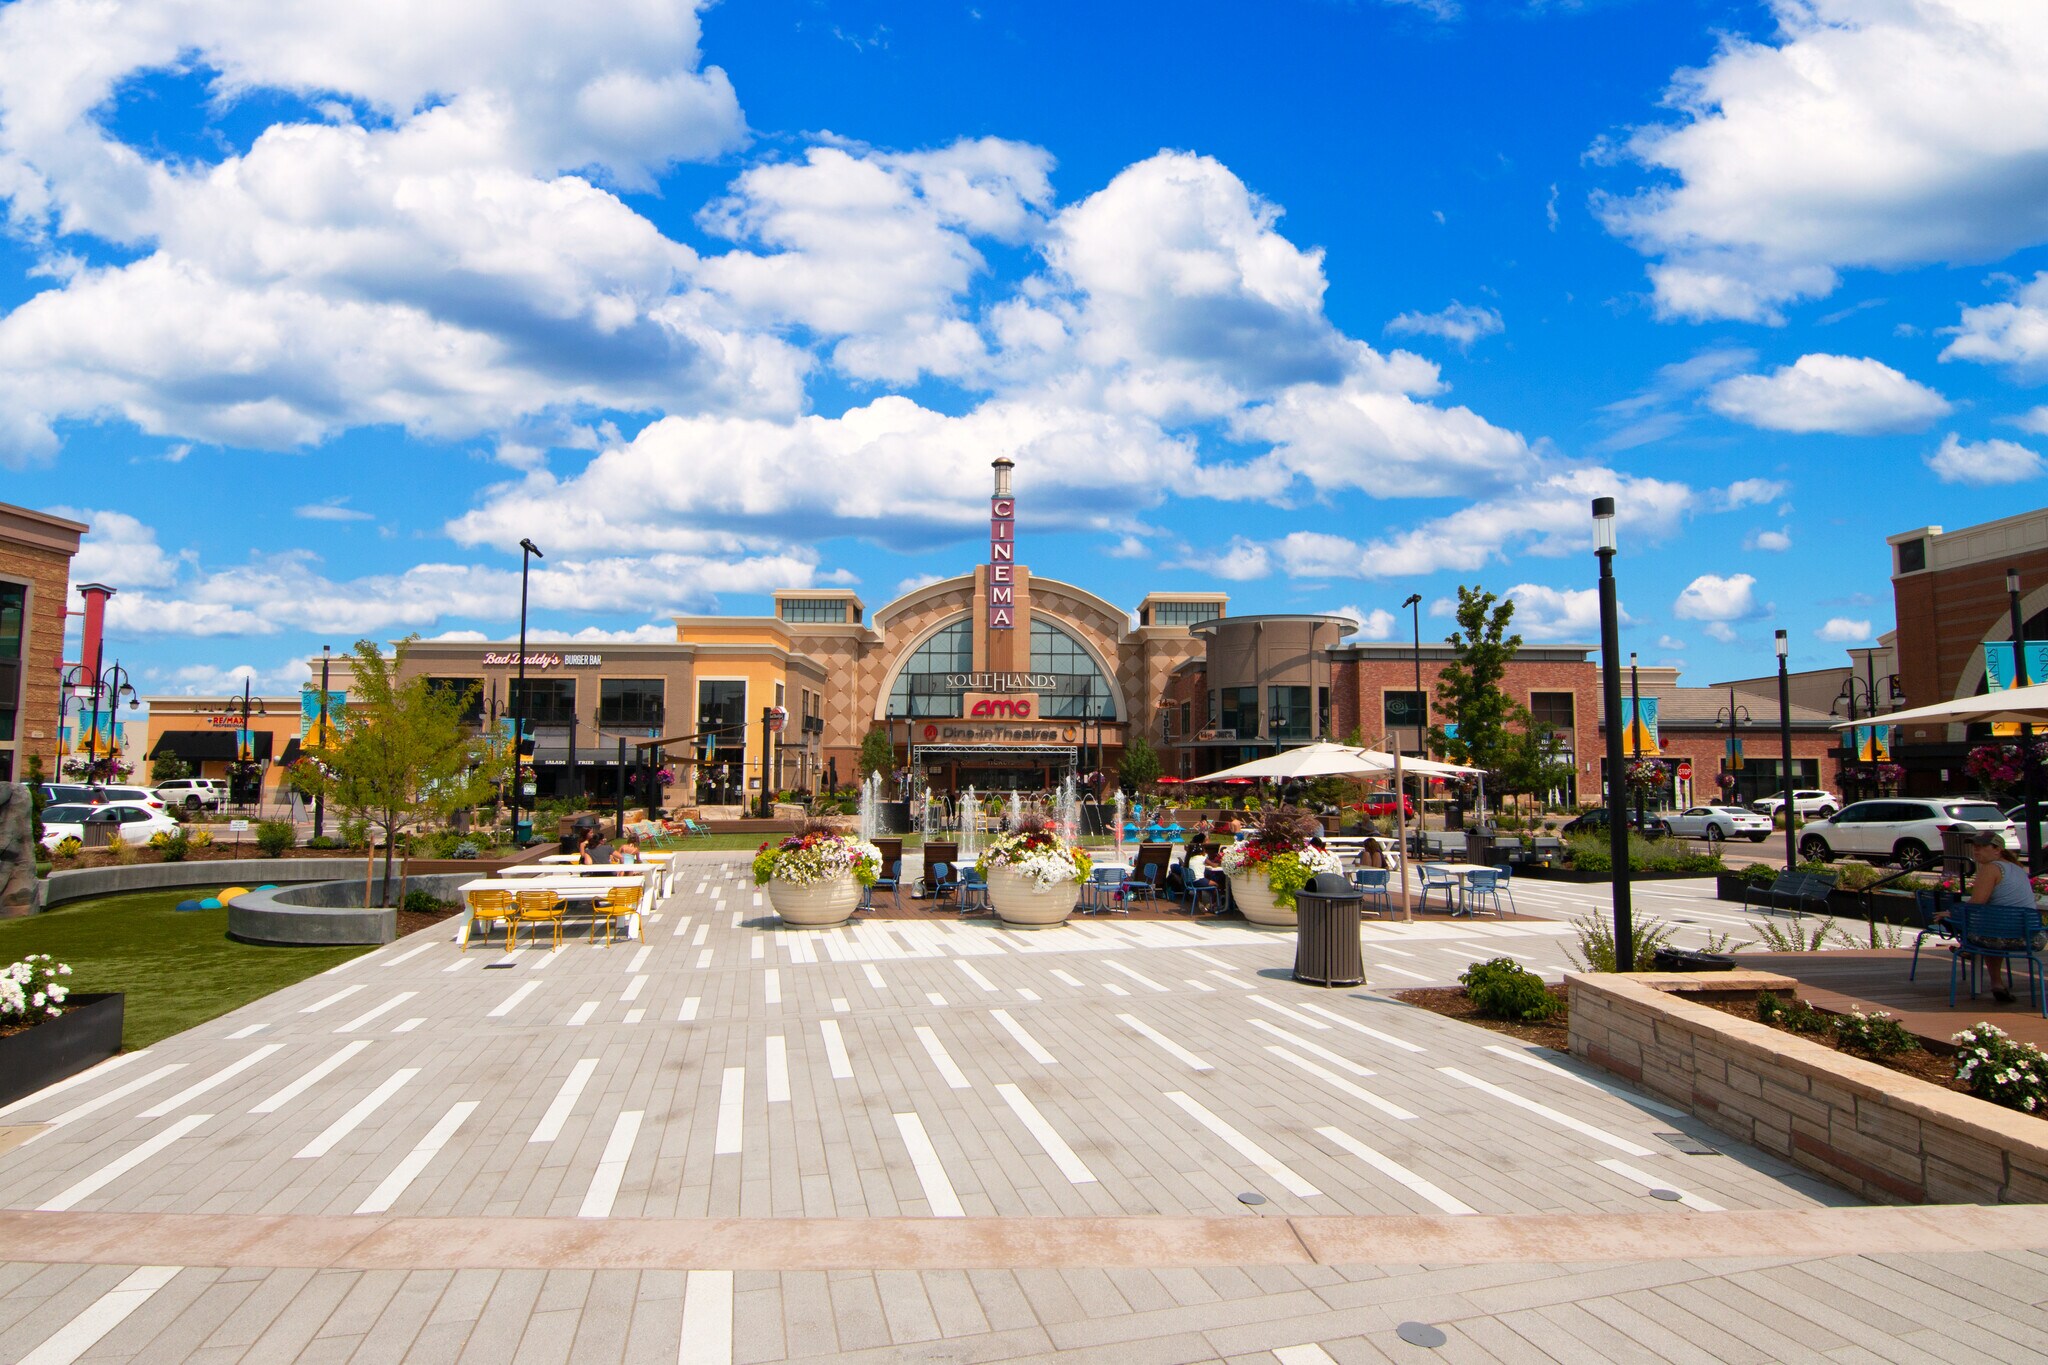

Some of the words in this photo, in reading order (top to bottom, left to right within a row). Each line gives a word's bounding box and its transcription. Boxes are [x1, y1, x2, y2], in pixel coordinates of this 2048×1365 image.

[993, 501, 1011, 625] CINEMA
[483, 652, 511, 664] Bad
[510, 652, 561, 668] Daddy's
[564, 655, 588, 665] BURGER
[589, 655, 601, 665] BAR
[946, 672, 1056, 692] SOUTHLANDS
[994, 727, 1057, 739] Theatres
